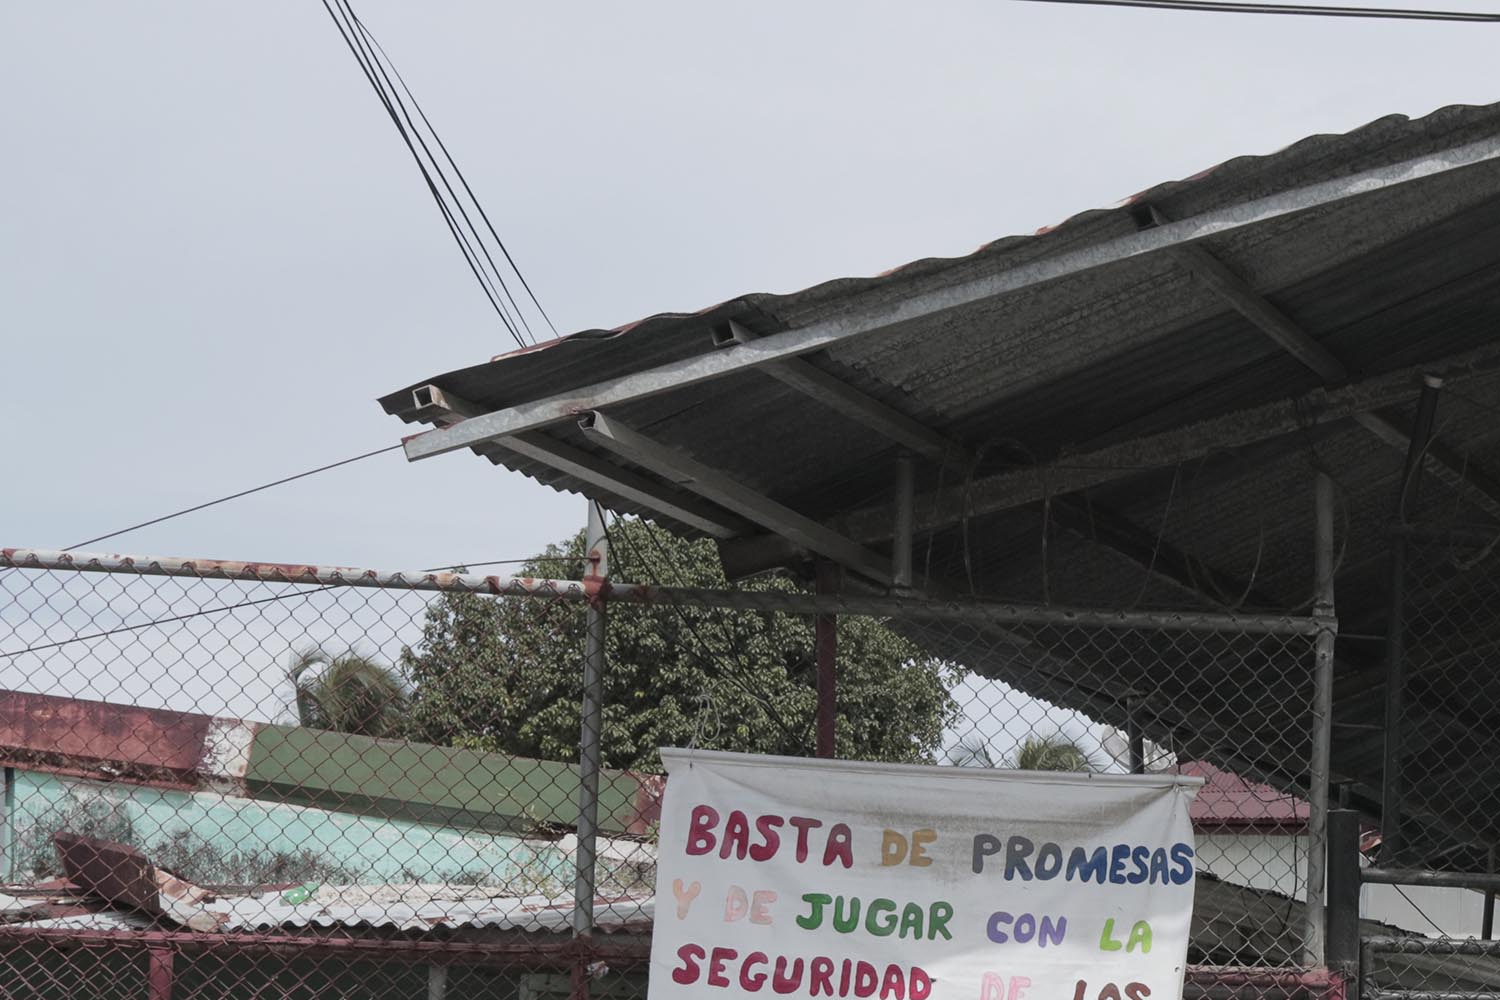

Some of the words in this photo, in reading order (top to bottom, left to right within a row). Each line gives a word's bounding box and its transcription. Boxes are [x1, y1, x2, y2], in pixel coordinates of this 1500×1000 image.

[686, 805, 852, 868] BASTA
[881, 828, 937, 868] DE
[972, 834, 1194, 886] PROMESAS
[672, 878, 702, 920] Y
[724, 885, 778, 925] DE
[796, 893, 953, 940] JUGAR
[986, 911, 1067, 948] CON
[1100, 918, 1152, 954] LA
[672, 944, 933, 1000] SEGURIDAD
